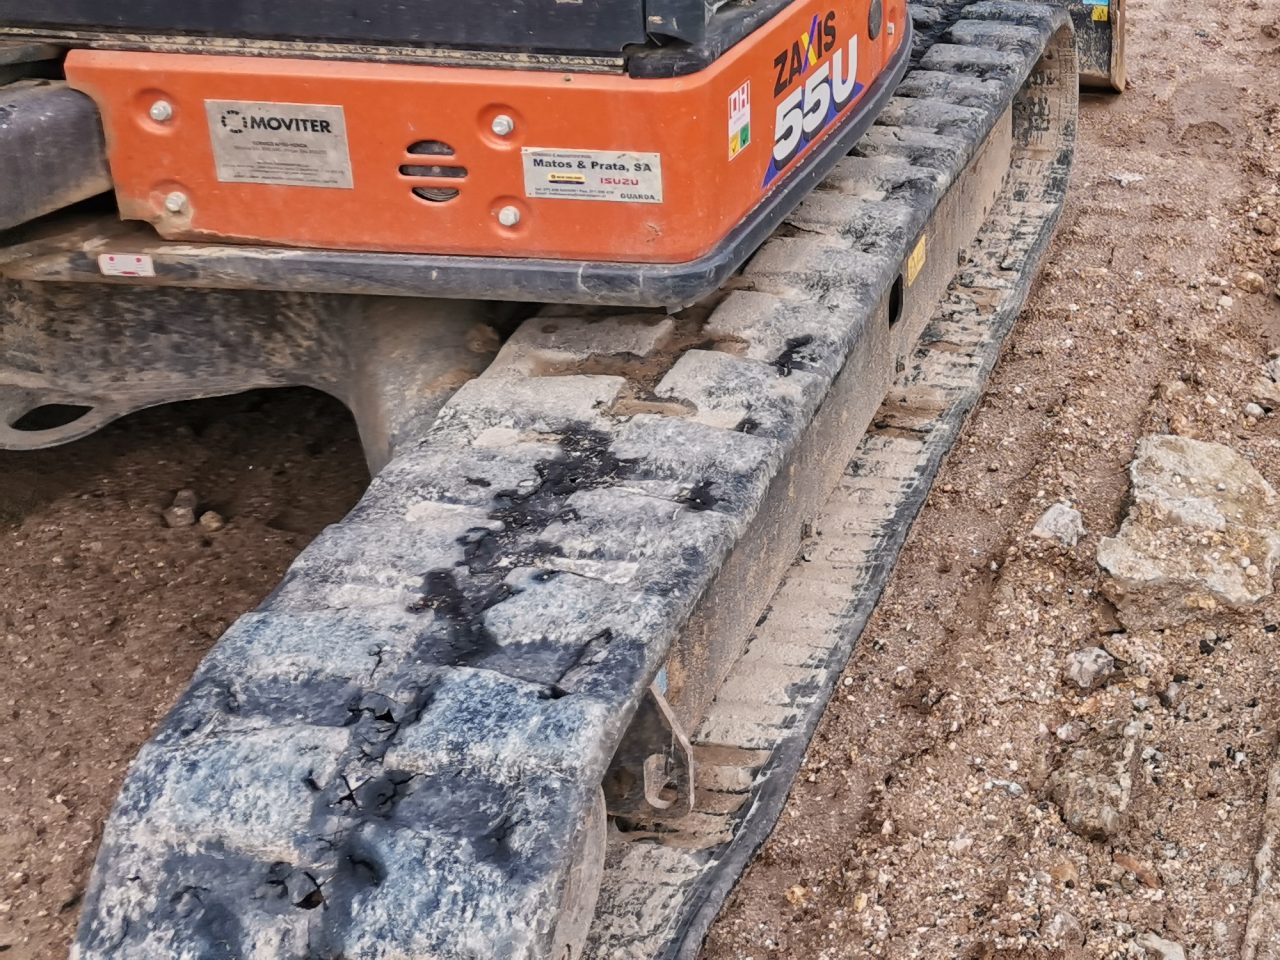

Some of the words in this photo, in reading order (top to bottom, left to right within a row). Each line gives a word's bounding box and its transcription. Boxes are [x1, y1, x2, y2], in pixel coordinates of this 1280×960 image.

[773, 10, 836, 99] ZAXIS
[773, 33, 858, 166] 55U
[250, 115, 332, 134] MOVITER
[533, 158, 573, 169] Matos
[576, 160, 587, 170] &
[591, 161, 630, 173] Prata,
[634, 163, 653, 173] SA
[600, 177, 640, 186] ISUZU
